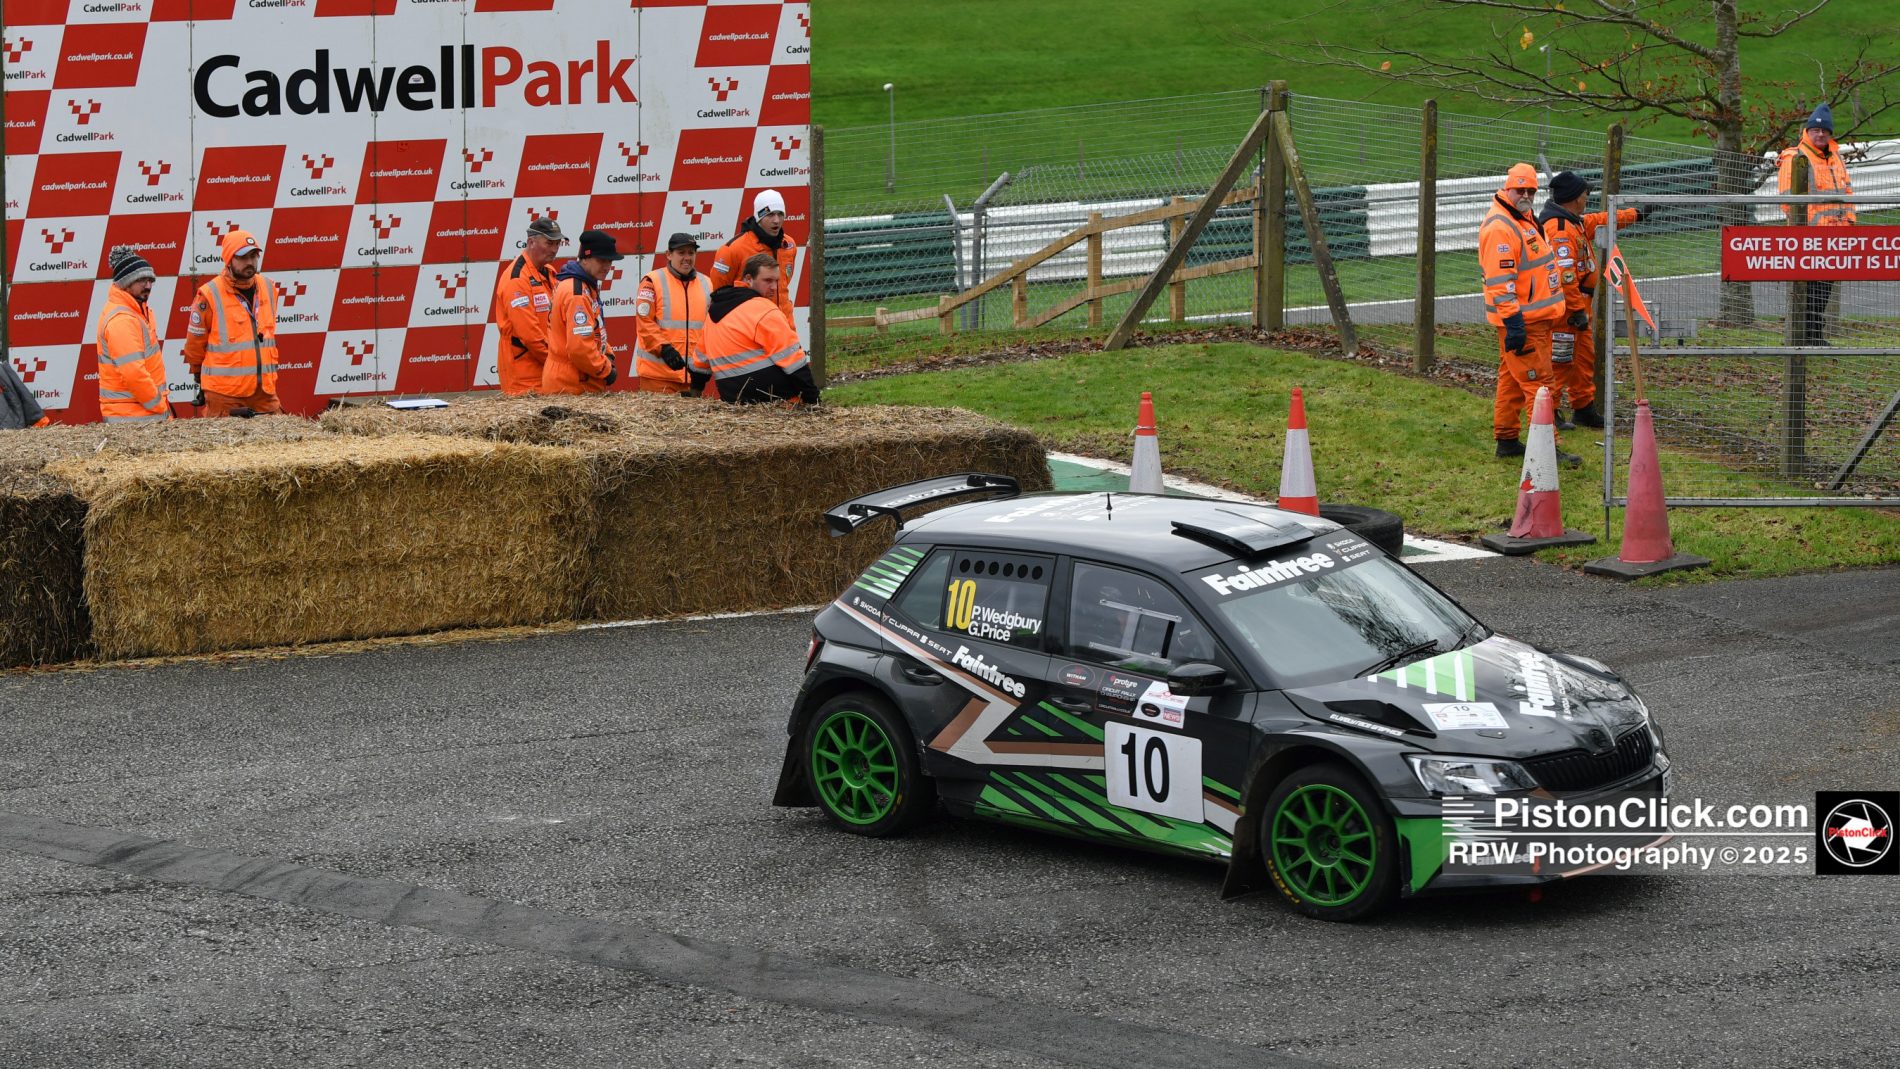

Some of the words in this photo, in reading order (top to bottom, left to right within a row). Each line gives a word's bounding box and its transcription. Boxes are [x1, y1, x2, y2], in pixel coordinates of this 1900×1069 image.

[83, 3, 142, 13] CadwellPark
[708, 31, 769, 42] cadwellpark.co.uk
[67, 51, 133, 62] cadwellpark.co.uk
[193, 40, 638, 118] CadwellPark
[697, 108, 750, 118] CadwellPark
[56, 132, 115, 142] CadwellPark
[682, 154, 743, 165] cadwellpark.co.uk
[528, 161, 590, 172] cadwellpark.co.uk
[370, 167, 434, 178] cadwellpark.co.uk
[607, 172, 661, 183] CadwellPark
[206, 174, 271, 185] cadwellpark.co.uk
[451, 179, 506, 190] CadwellPark
[41, 181, 107, 191] cadwellpark.co.uk
[290, 185, 347, 197] CadwellPark
[126, 192, 184, 203] CadwellPark
[593, 220, 654, 230] cadwellpark.co.uk
[436, 227, 499, 237] cadwellpark.co.uk
[274, 233, 339, 245] cadwellpark.co.uk
[1730, 237, 1771, 251] GATE
[1776, 237, 1798, 251] TO
[1803, 237, 1822, 251] BE
[1827, 237, 1868, 251] KEPT
[357, 244, 413, 257] CadwellPark
[29, 260, 88, 271] CadwellPark
[1746, 256, 1795, 269] WHEN
[1799, 256, 1862, 269] CIRCUIT
[1867, 256, 1880, 269] IS
[342, 294, 405, 304] cadwellpark.co.uk
[13, 310, 80, 320] cadwellpark.co.uk
[424, 305, 480, 316] CadwellPark
[409, 353, 472, 363] cadwellpark.co.uk
[330, 371, 387, 383] CadwellPark
[1201, 553, 1335, 596] Faintree
[947, 579, 977, 630] 10
[971, 605, 1042, 634] P.Wedgbury
[888, 618, 920, 638] CUPRA
[927, 639, 952, 656] SEAT
[968, 621, 1011, 642] G.Price
[952, 645, 1026, 698] Faintree
[1113, 677, 1138, 689] protyre
[1121, 732, 1170, 803] 10
